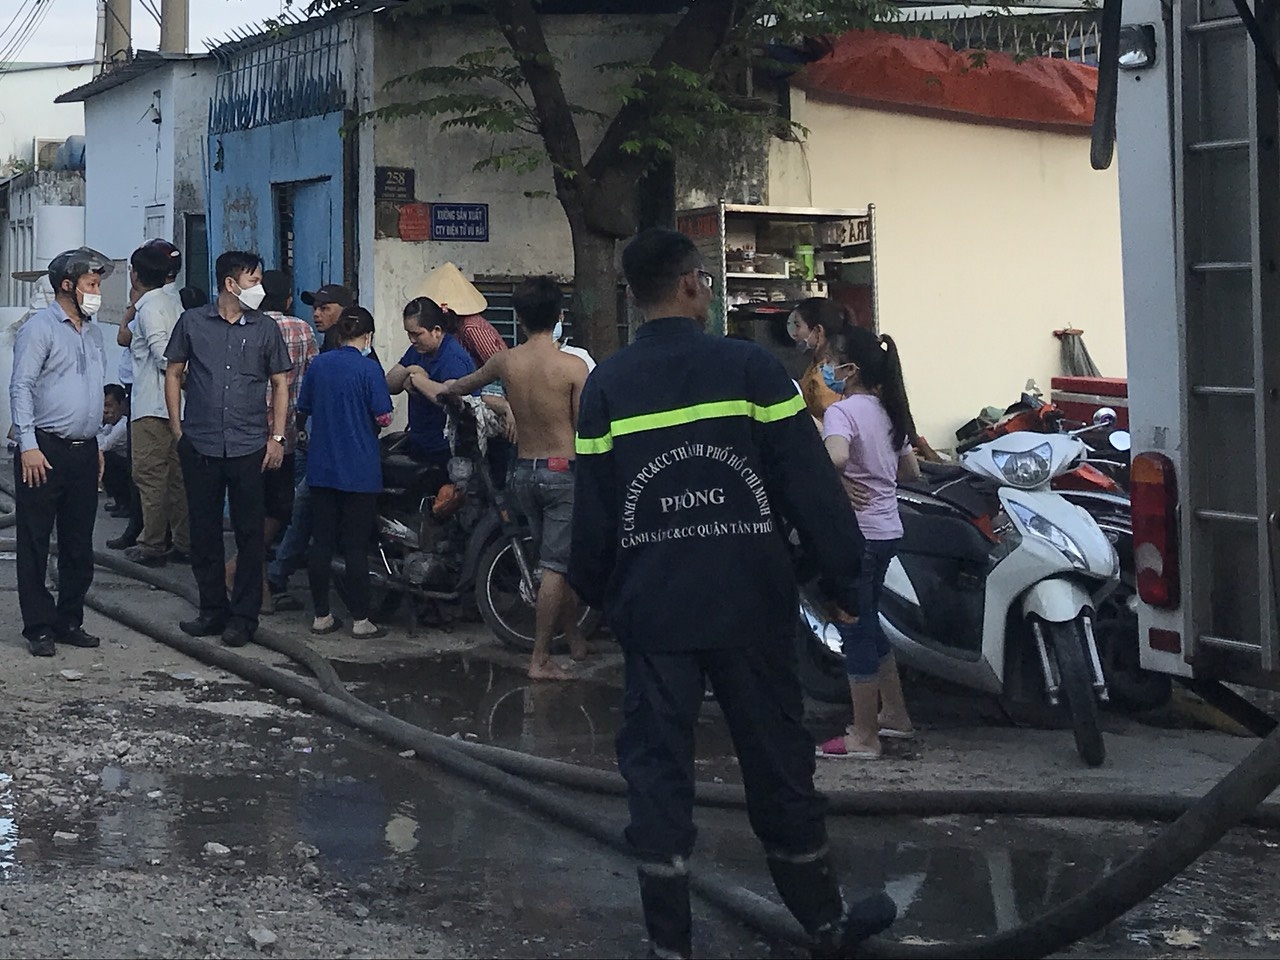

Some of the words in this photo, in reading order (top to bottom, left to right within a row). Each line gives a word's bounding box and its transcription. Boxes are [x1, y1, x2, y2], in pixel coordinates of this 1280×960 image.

[386, 172, 405, 185] 258
[435, 225, 445, 235] CTY
[626, 479, 644, 502] SÁT
[636, 453, 672, 483] PC&CC
[706, 445, 733, 462] PHỐ
[740, 467, 762, 489] CHÍ
[752, 486, 771, 516] MINH
[660, 488, 725, 513] PHÒNG
[621, 532, 649, 548] CẢNH
[697, 521, 728, 538] QUẬN
[730, 520, 751, 535] TÂN
[753, 518, 774, 534] PHÚ
